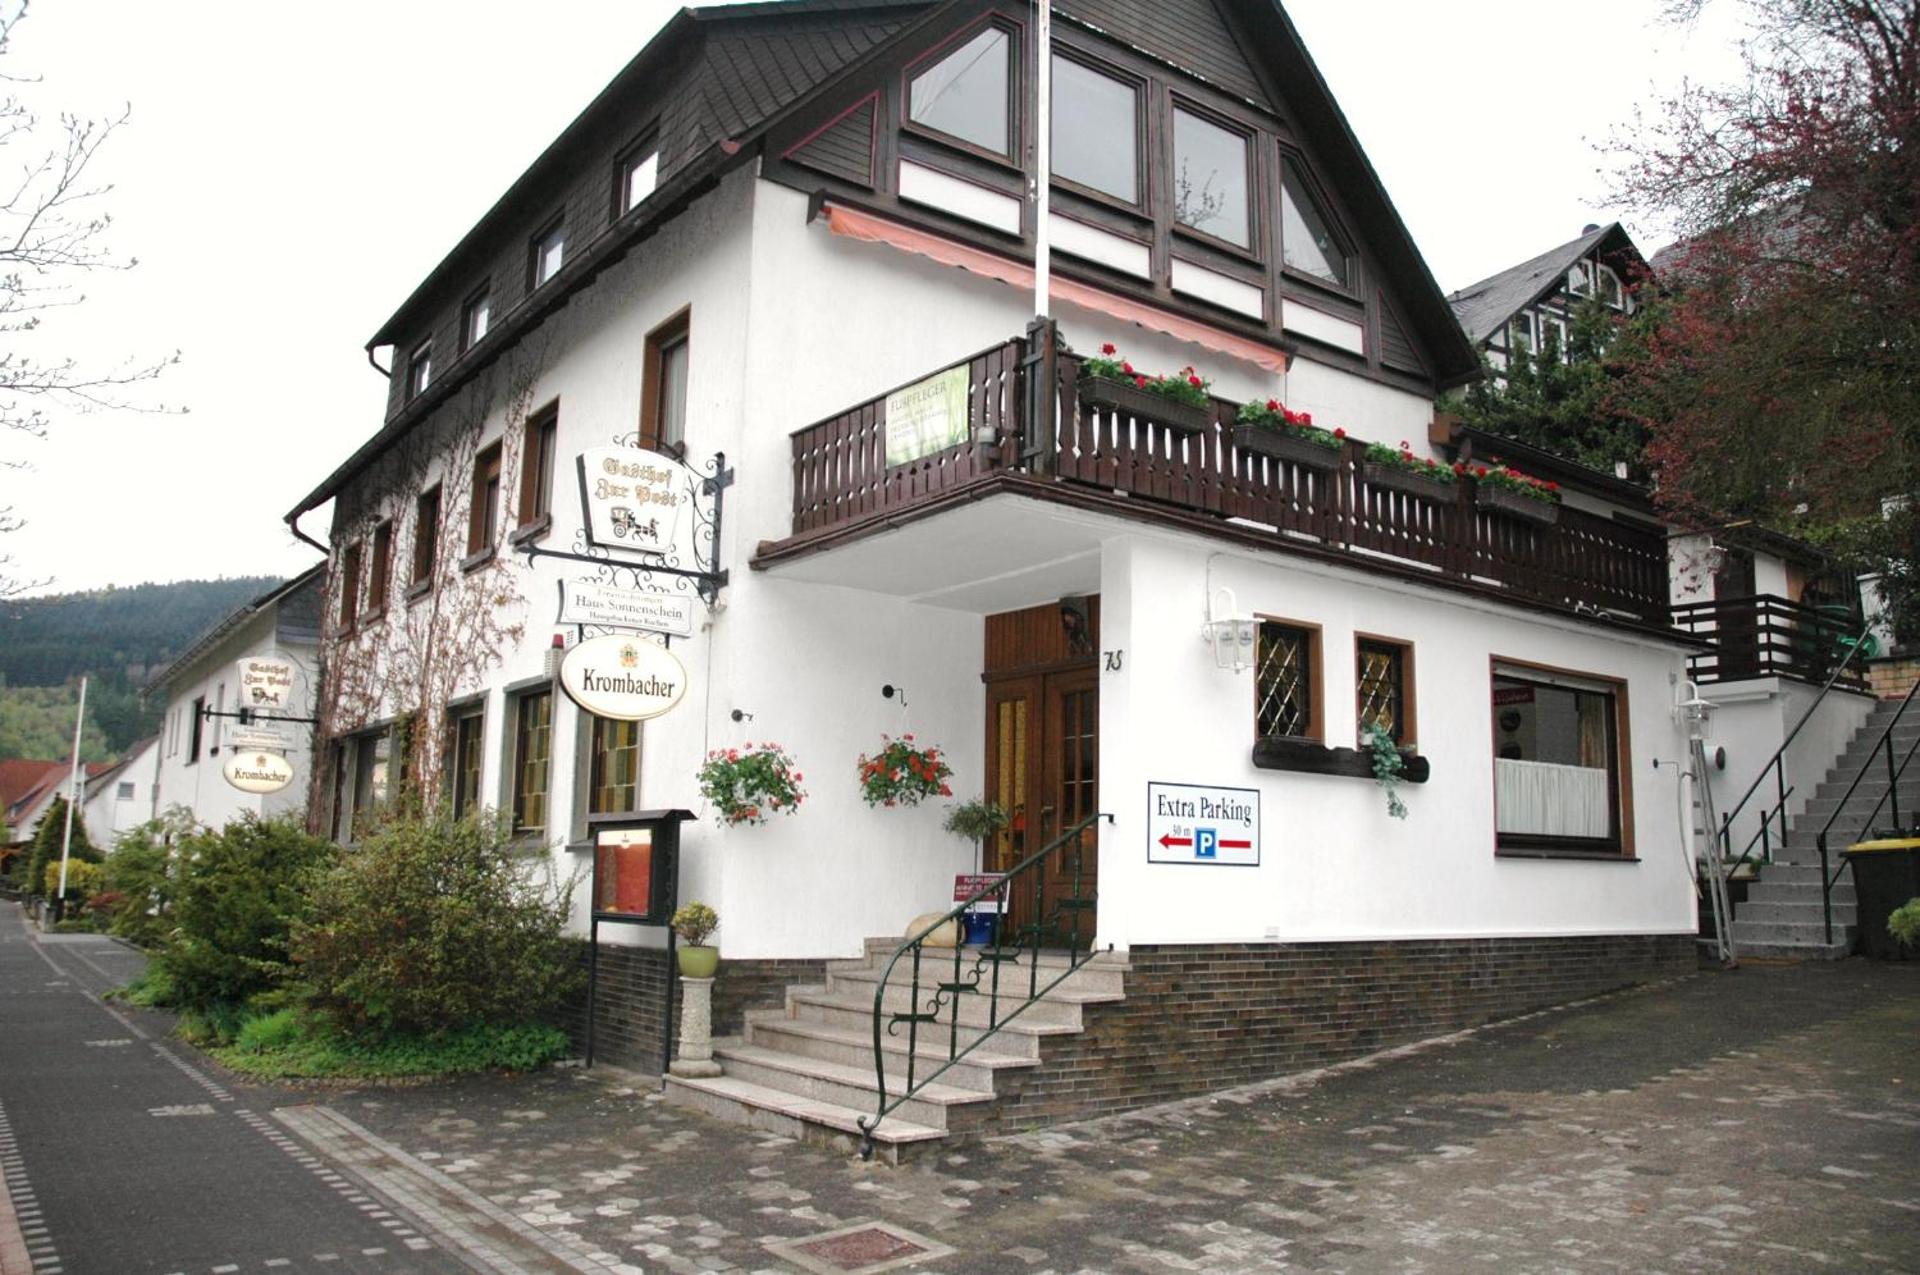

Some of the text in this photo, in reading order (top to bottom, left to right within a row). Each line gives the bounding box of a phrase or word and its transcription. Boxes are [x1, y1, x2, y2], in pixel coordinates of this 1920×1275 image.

[602, 457, 673, 488] Gasthof
[595, 478, 678, 507] Zur Post
[576, 595, 683, 619] Haus Sonnenschein
[1104, 649, 1123, 671] 75
[583, 667, 676, 698] Krombacher
[234, 767, 287, 782] Krombacher
[1157, 794, 1252, 828] Extra Parking
[1200, 832, 1213, 854] P
